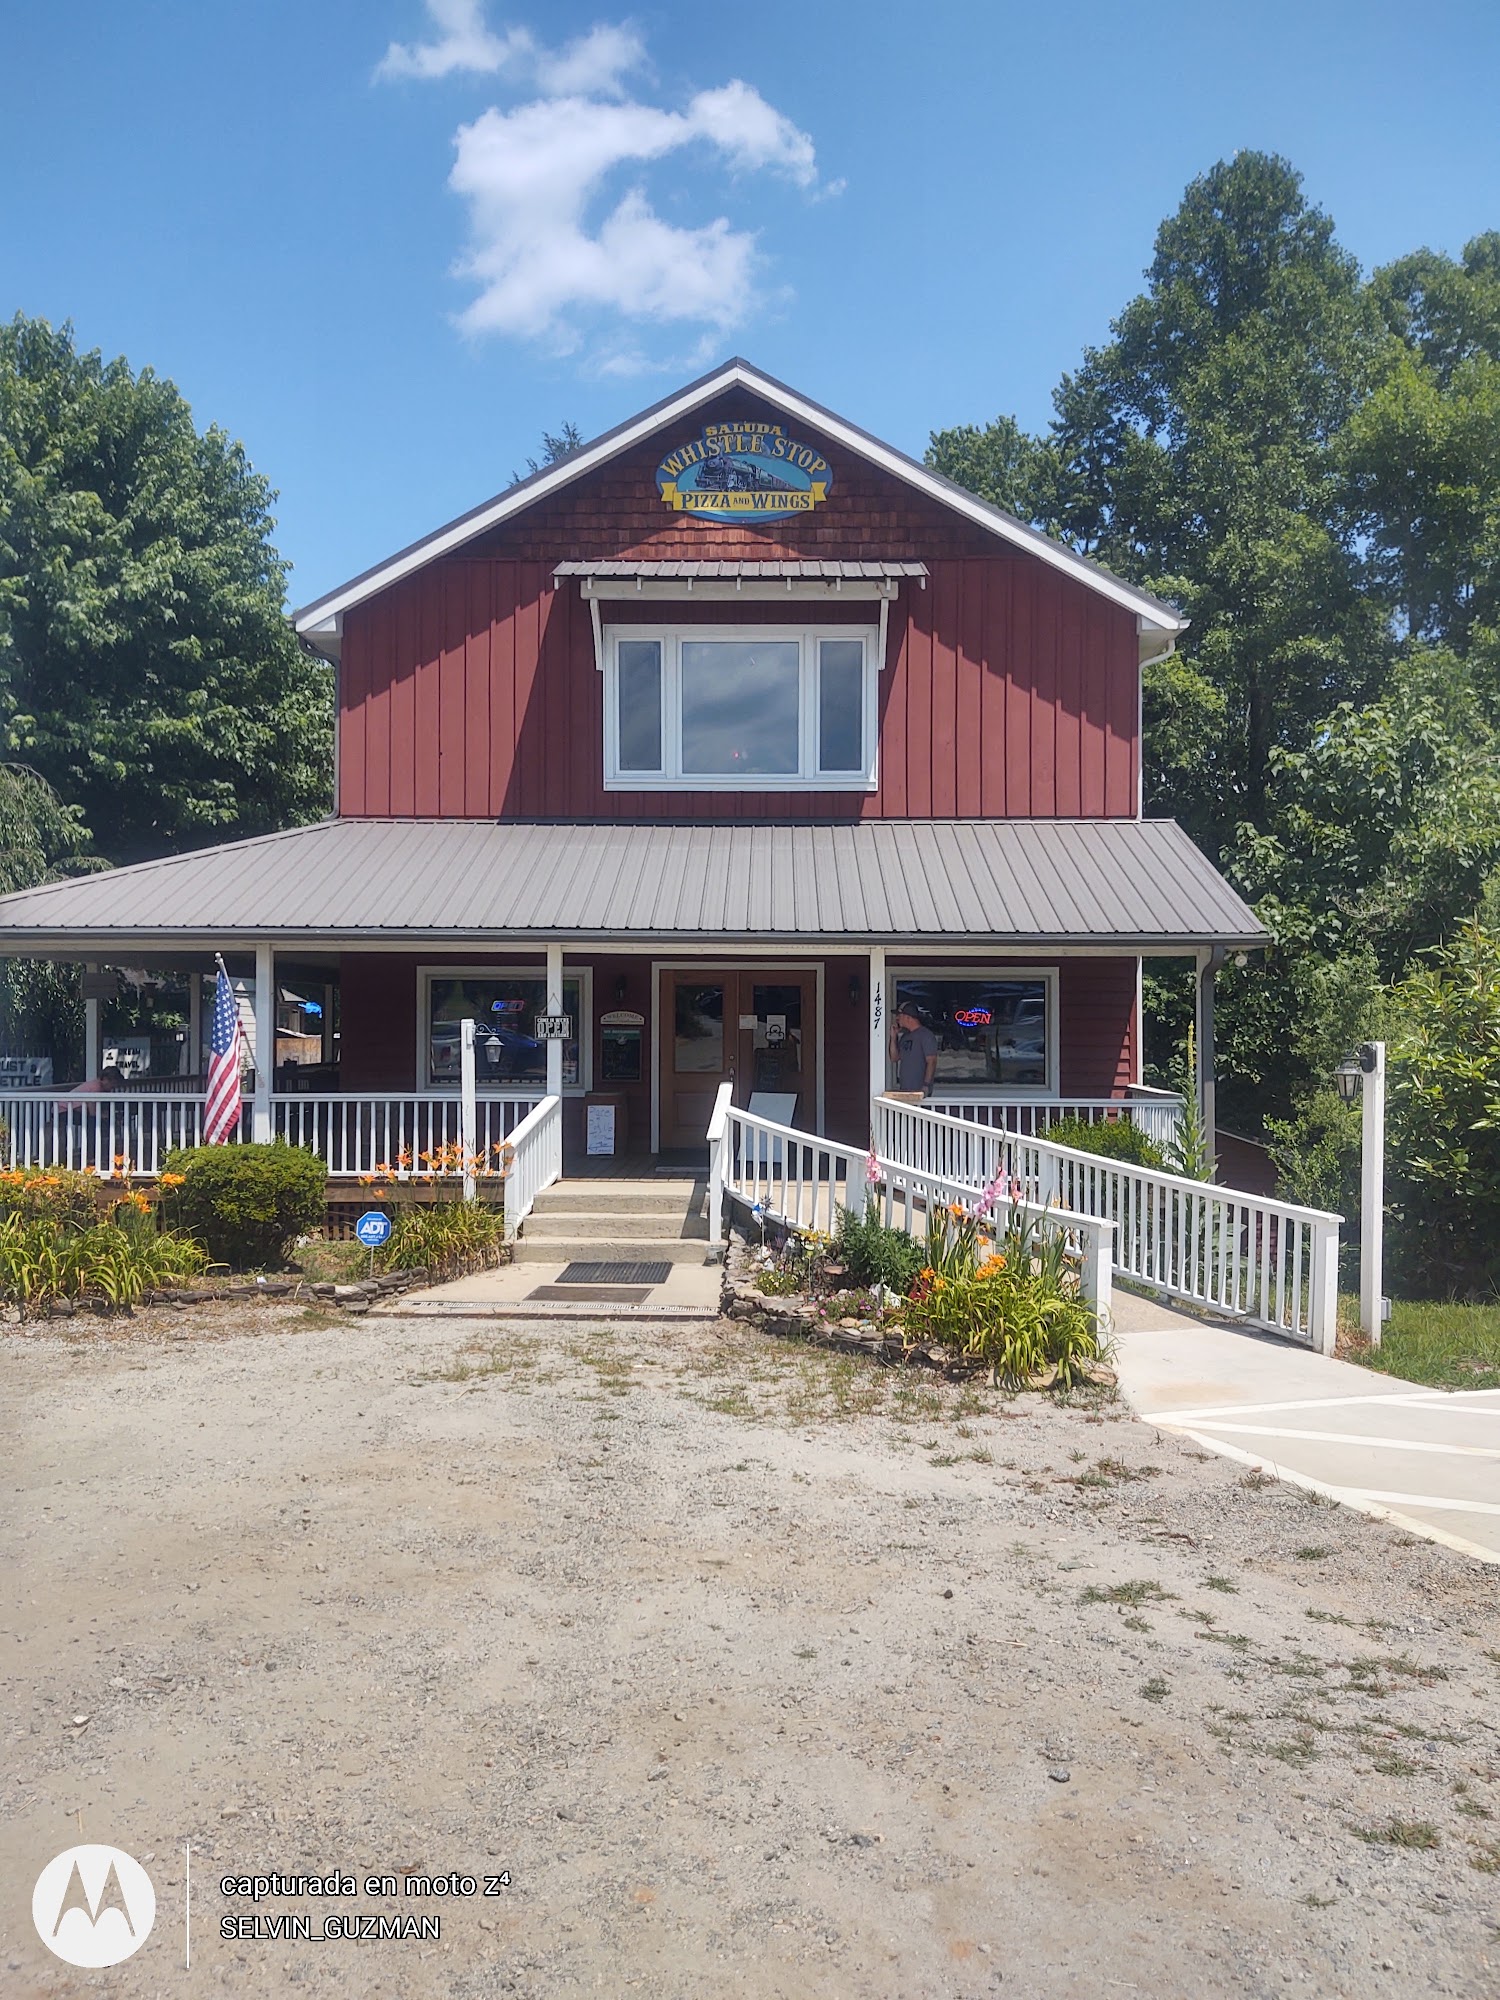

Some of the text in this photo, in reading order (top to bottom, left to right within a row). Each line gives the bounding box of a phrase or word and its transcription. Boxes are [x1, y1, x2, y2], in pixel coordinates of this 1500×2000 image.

[705, 424, 783, 436] SALUDA
[660, 434, 827, 477] WHISTLE STOP
[681, 492, 810, 509] PIZZA AND WINGS
[606, 1012, 639, 1021] WELCOME
[954, 1010, 991, 1024] OPEN
[536, 1022, 569, 1034] OPEN
[0, 1060, 26, 1071] UST
[360, 1221, 388, 1235] ADT
